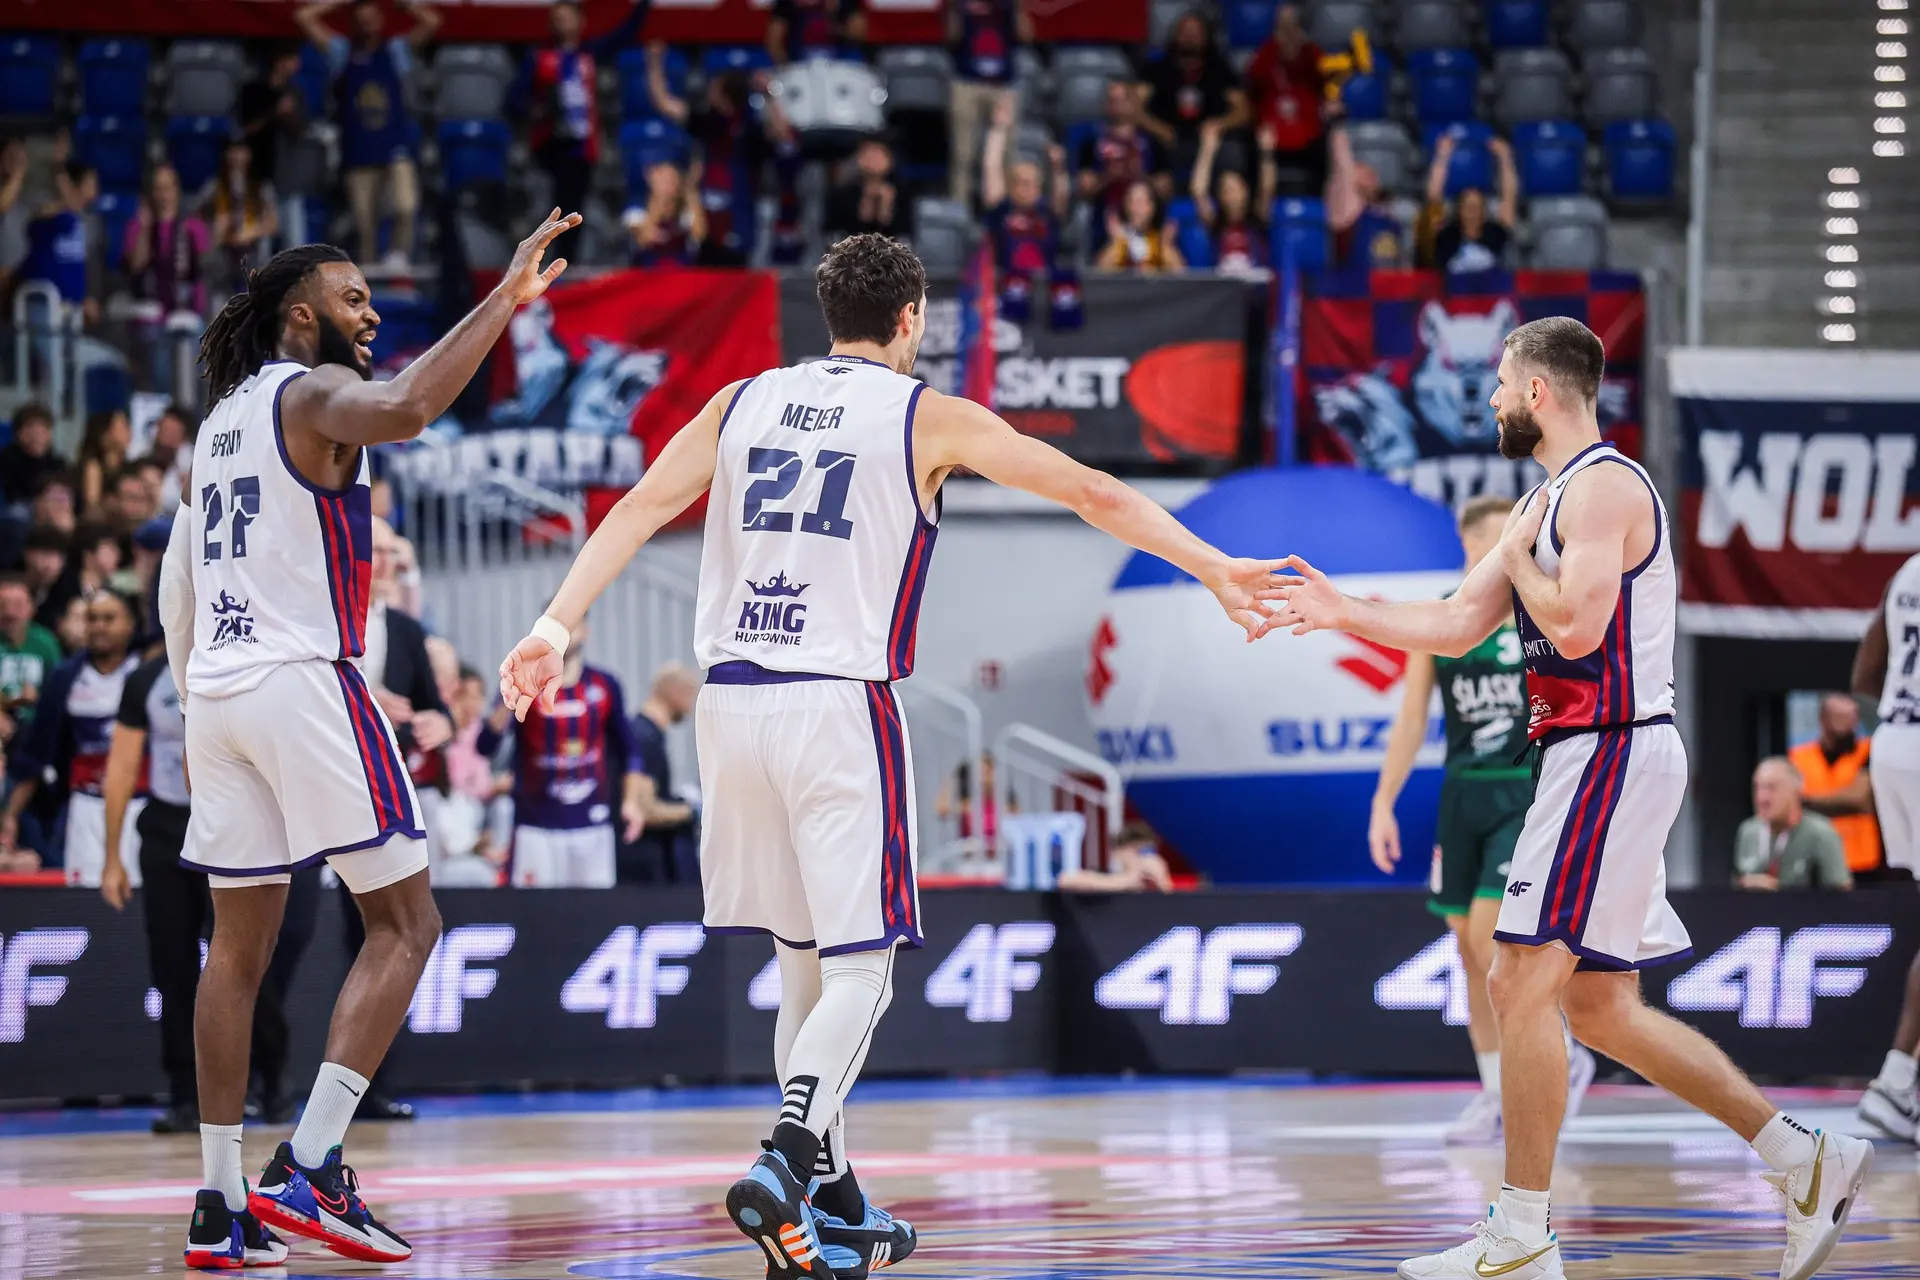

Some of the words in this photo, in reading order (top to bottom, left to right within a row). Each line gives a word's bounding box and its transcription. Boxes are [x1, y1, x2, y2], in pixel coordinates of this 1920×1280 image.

[780, 402, 845, 433] MEIER
[742, 446, 857, 540] 21
[737, 601, 807, 633] KING
[734, 630, 802, 646] HURTOWNIE
[1507, 880, 1533, 897] 4F
[0, 927, 91, 1043] F
[560, 922, 705, 1028] 4F
[924, 920, 1056, 1023] 4F
[1094, 923, 1305, 1026] 4F
[1373, 930, 1472, 1026] 4
[1666, 923, 1895, 1029] 4F
